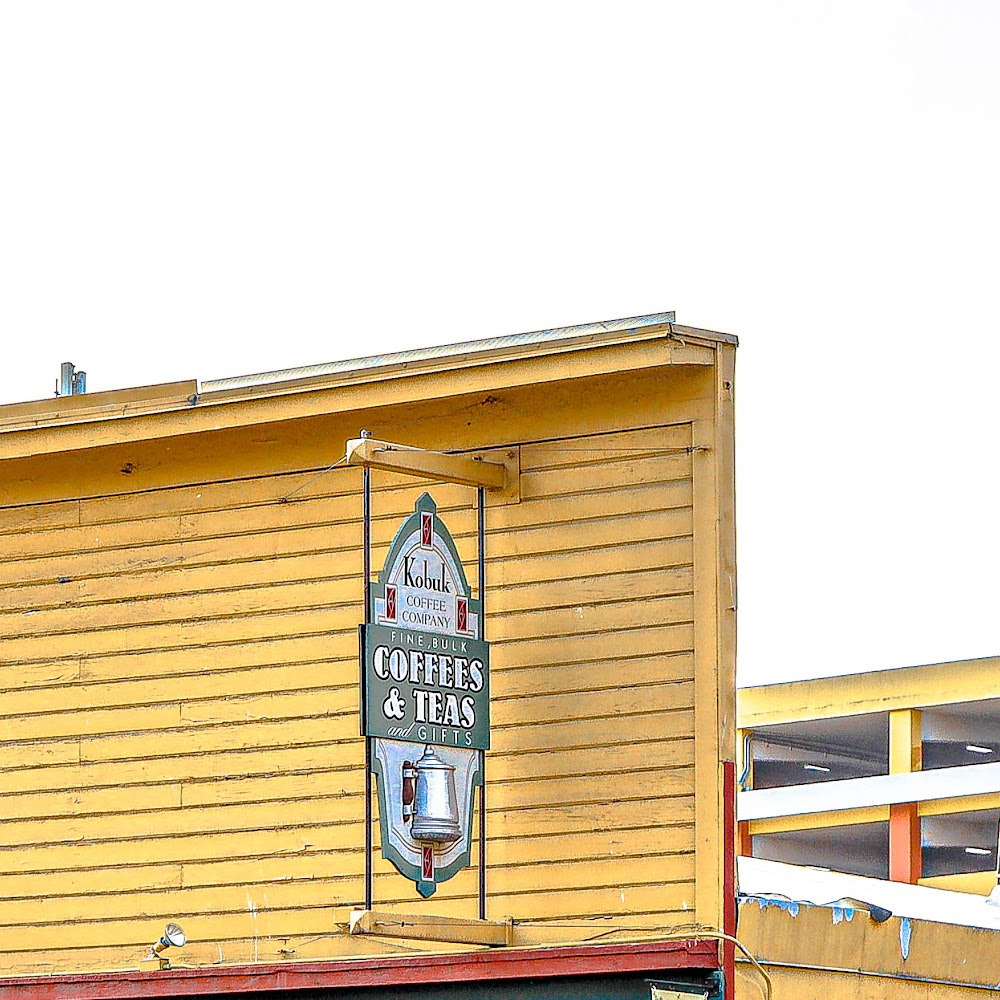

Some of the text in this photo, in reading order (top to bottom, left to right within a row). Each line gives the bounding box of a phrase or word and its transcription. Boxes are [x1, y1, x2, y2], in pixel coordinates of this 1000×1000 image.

[404, 556, 451, 593] Kobuk
[406, 595, 446, 612] COFFEE
[402, 611, 451, 628] COMPANY
[432, 637, 467, 653] BULK
[373, 645, 484, 693] COFFEES
[383, 686, 476, 729] & TEAS
[387, 722, 473, 746] and GIFTS
